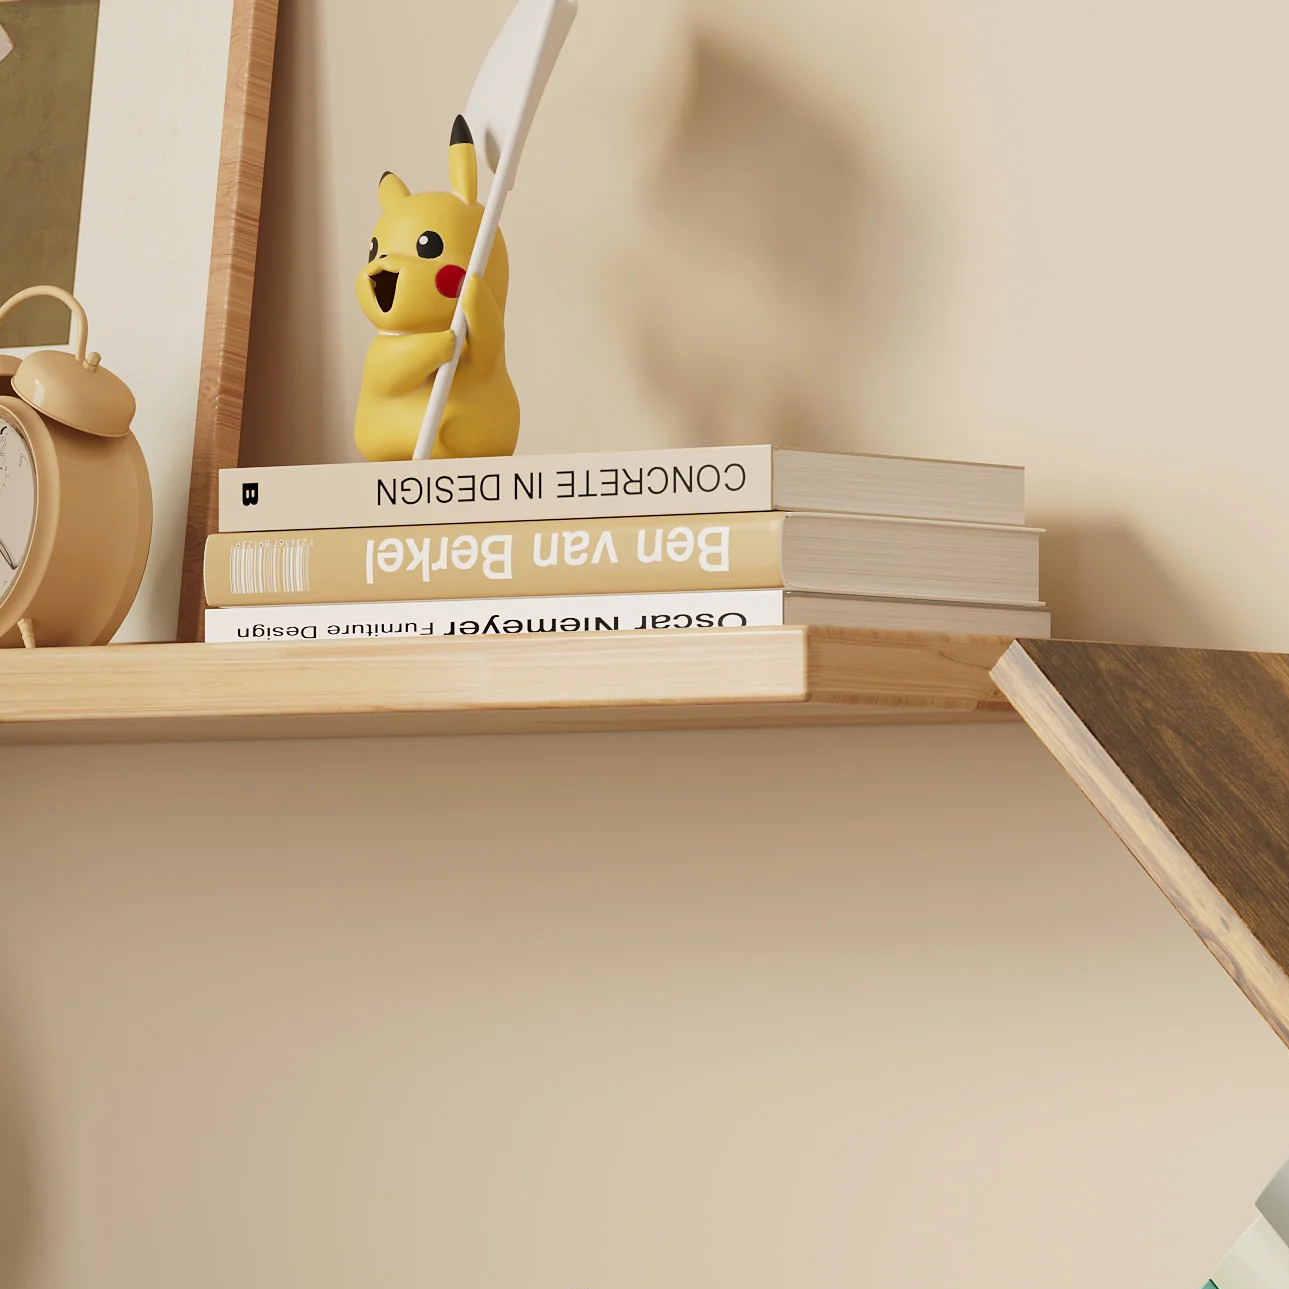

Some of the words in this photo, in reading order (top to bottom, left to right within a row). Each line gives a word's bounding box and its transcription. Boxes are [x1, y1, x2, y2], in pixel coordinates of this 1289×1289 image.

[242, 482, 259, 506] B
[377, 473, 500, 506] DESIGN
[514, 471, 543, 500] IN
[557, 463, 746, 498] CONCRETE
[366, 534, 513, 585] Berkel
[533, 530, 619, 567] van
[637, 527, 730, 572] Ben
[237, 625, 317, 640] Design
[327, 622, 434, 638] Furniture
[444, 614, 620, 636] Niemeyer
[635, 612, 748, 630] Oscar
